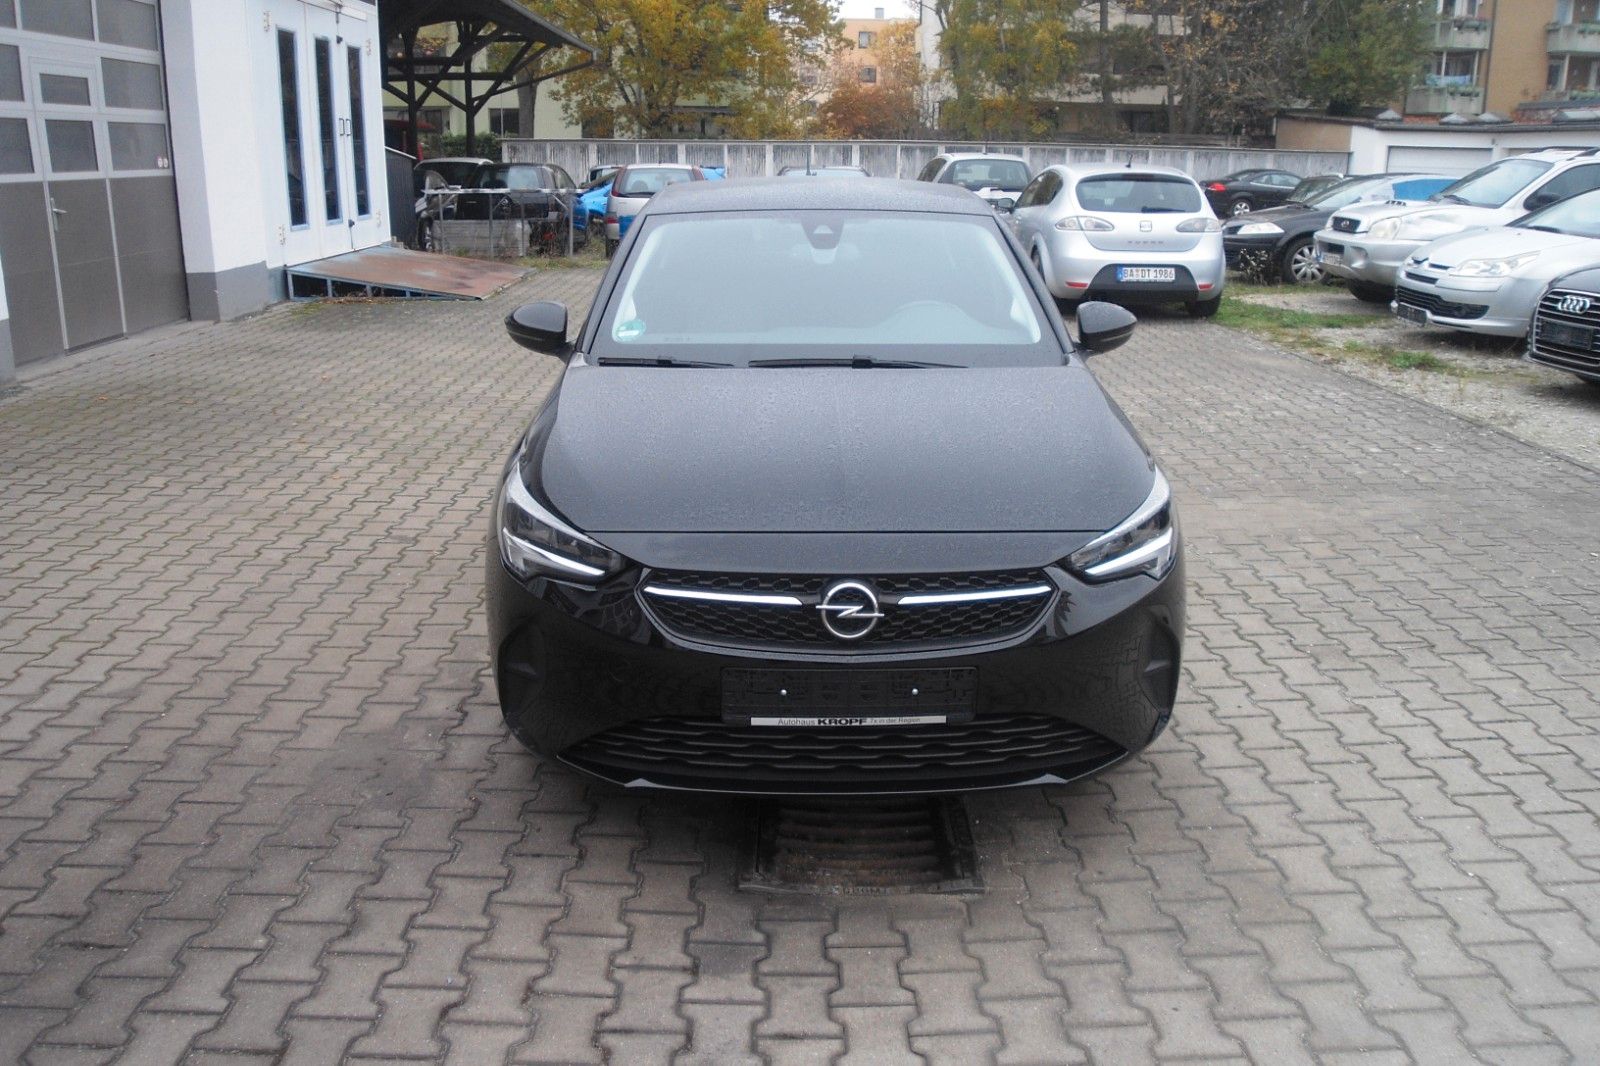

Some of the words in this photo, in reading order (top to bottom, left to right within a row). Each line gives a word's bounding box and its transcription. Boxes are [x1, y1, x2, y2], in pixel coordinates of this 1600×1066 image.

[1141, 269, 1151, 278] DT
[1153, 269, 1174, 278] 1986
[777, 717, 816, 726] Autohaus
[817, 717, 868, 726] KROPF
